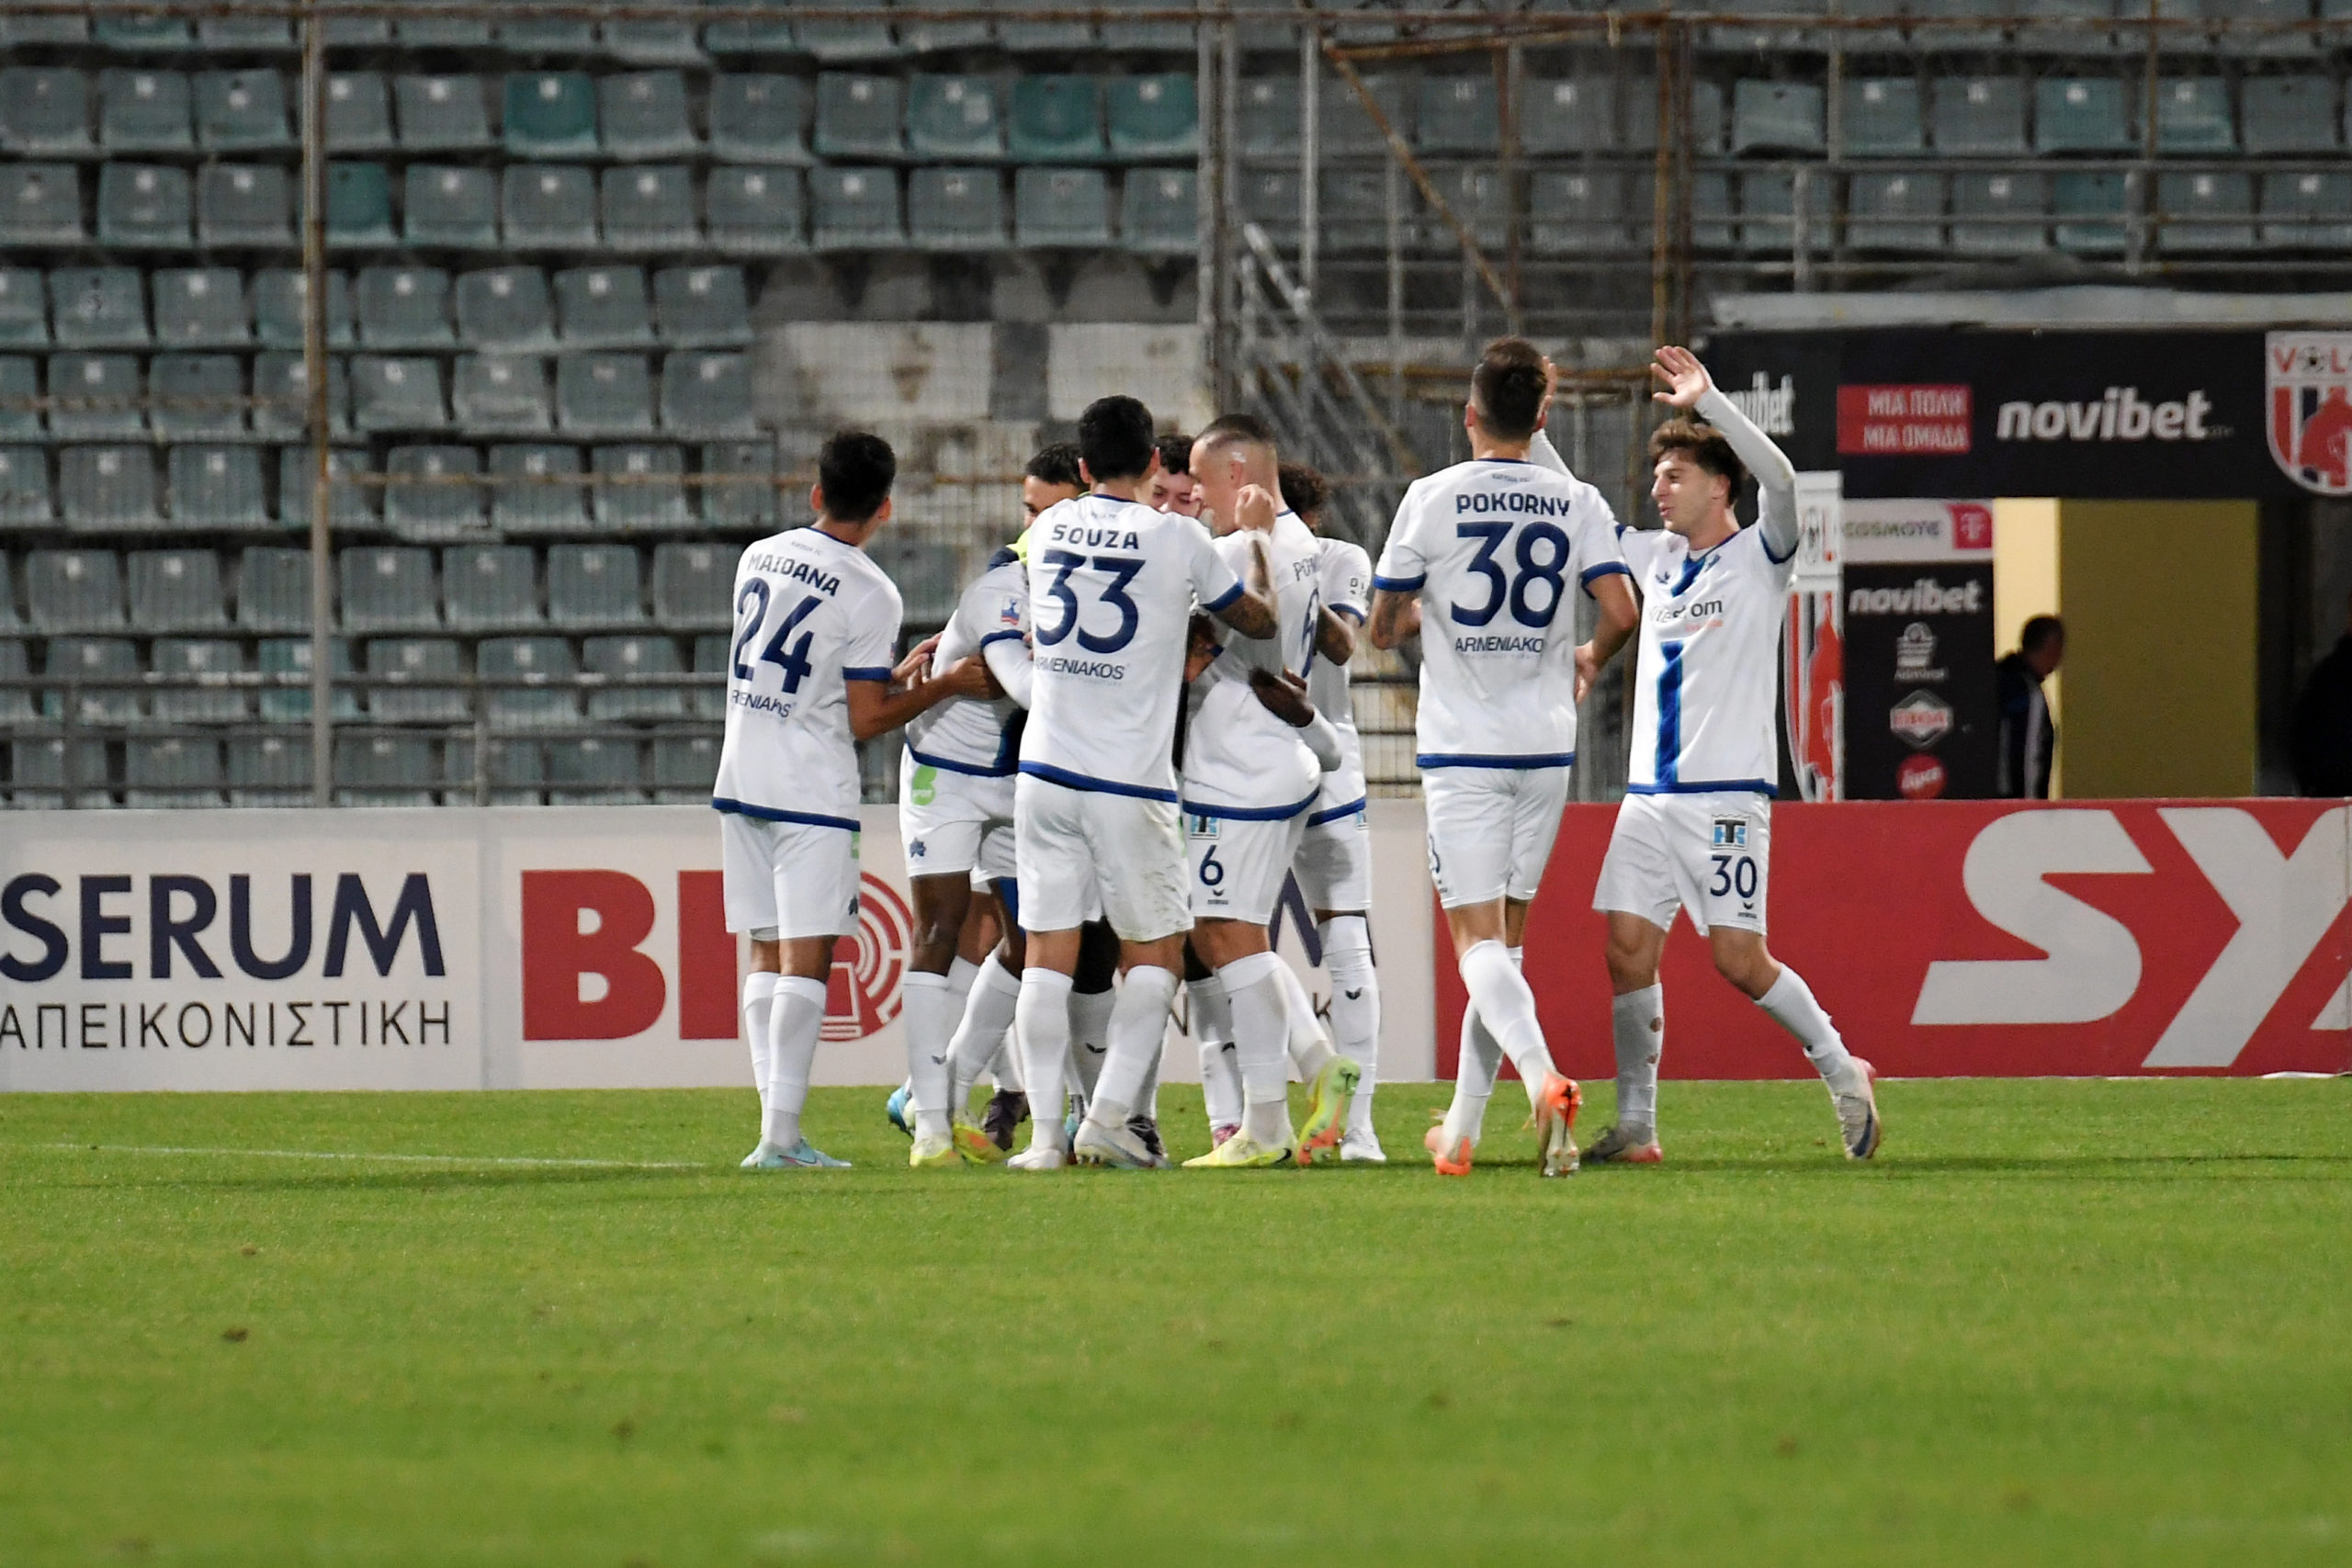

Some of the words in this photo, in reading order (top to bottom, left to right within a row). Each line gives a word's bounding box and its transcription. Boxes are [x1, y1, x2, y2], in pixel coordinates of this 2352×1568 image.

[1868, 390, 1906, 416] ΜΙΑ
[1910, 390, 1965, 416] ΠΟΛΗ
[1996, 387, 2211, 440] novibet
[1864, 424, 1898, 448] ΜΙΑ
[1902, 424, 1965, 448] ΟΜΑΔΑ
[1456, 493, 1571, 516] POKORNY
[1052, 525, 1139, 550] SOUZA
[748, 553, 841, 596] MAIDANA
[1451, 521, 1570, 627] 38
[1036, 549, 1147, 654] 33
[1849, 579, 1981, 614] novibet
[734, 577, 823, 694] 24
[1199, 844, 1224, 886] 6
[1710, 854, 1758, 898] 30
[0, 873, 447, 982] SERUM
[1911, 807, 2352, 1069] SY
